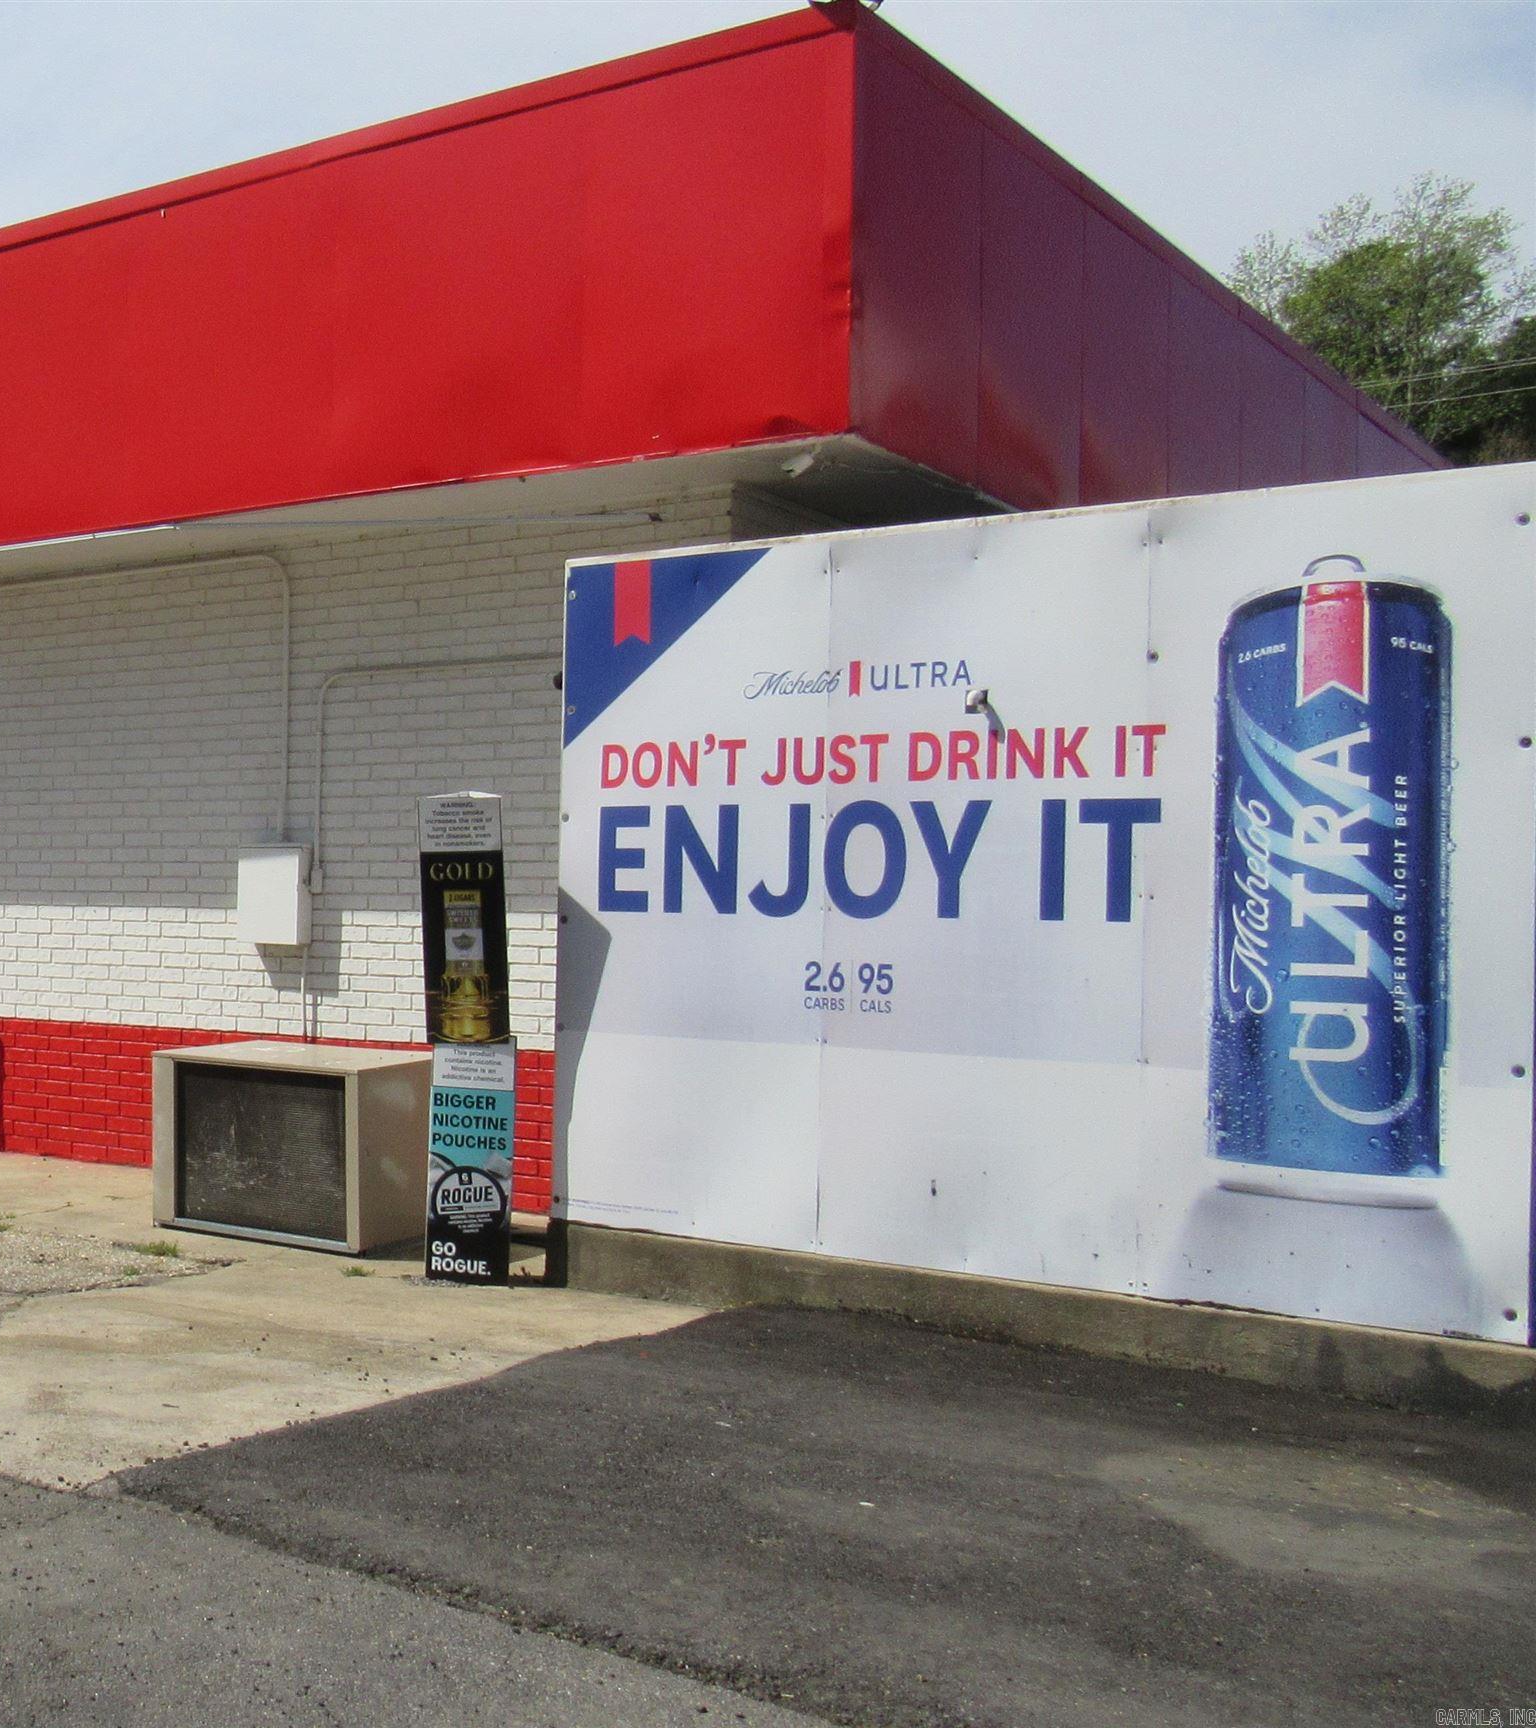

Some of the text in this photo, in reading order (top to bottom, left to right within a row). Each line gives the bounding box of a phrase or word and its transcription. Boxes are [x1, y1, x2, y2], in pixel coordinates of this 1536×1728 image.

[1253, 643, 1287, 658] CARBS
[1390, 637, 1433, 654] 95 CALS
[743, 660, 972, 699] Michelob ULTRA
[600, 724, 1167, 789] DON'T JUST DRINK IT
[598, 798, 1162, 922] ENJOY IT
[1230, 776, 1273, 1014] Michelob
[1289, 729, 1370, 1064] ULTRA
[1393, 774, 1408, 1024] SUPERIOR LIGHT BEER
[805, 961, 893, 995] 2.6 95
[804, 997, 892, 1013] CARBS CALS
[433, 1092, 497, 1110] BIGGER
[433, 1113, 508, 1131] NICOTINE
[432, 1132, 507, 1151] POUCHES
[441, 1186, 494, 1204] ROGUE
[431, 1240, 456, 1256] GO
[431, 1256, 491, 1276] ROGUE.
